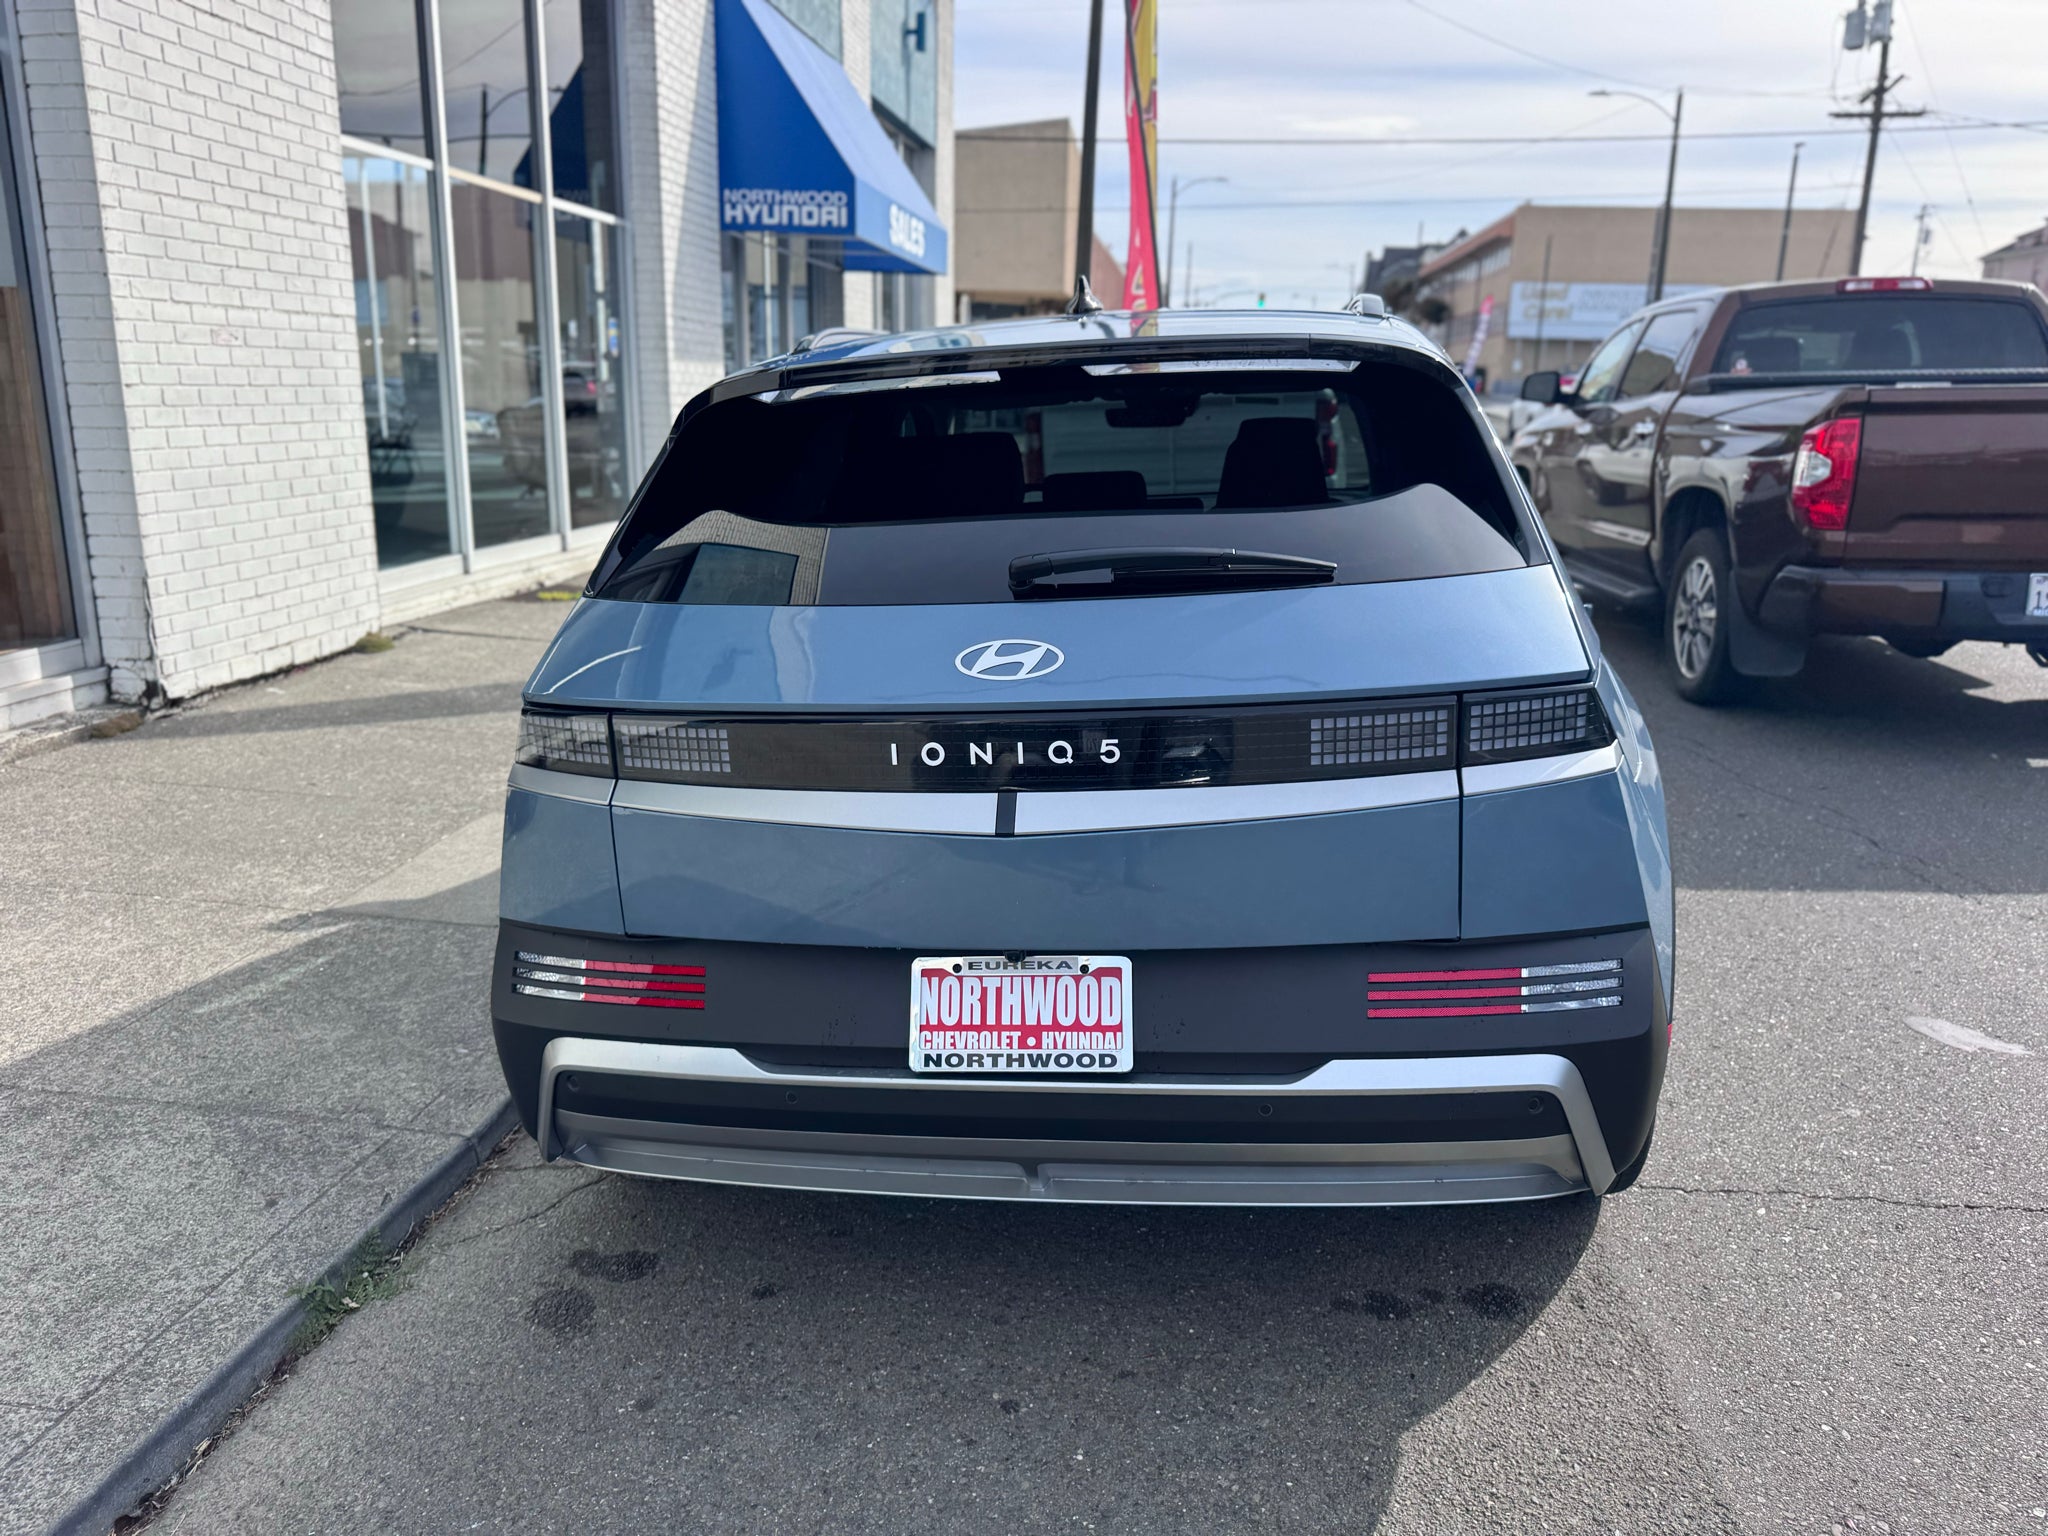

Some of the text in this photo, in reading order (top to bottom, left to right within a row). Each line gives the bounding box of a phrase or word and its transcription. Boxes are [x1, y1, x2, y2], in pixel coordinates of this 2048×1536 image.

[723, 188, 847, 206] NORTHWOOD
[724, 203, 848, 228] HYUNDAI
[889, 203, 925, 257] SALES
[967, 960, 1073, 971] EUREKA
[920, 976, 1122, 1027] NORTHWOOD
[920, 1031, 1122, 1050] CHEVROLET HYUNDAI
[924, 1053, 1118, 1068] NORTHWOOD
